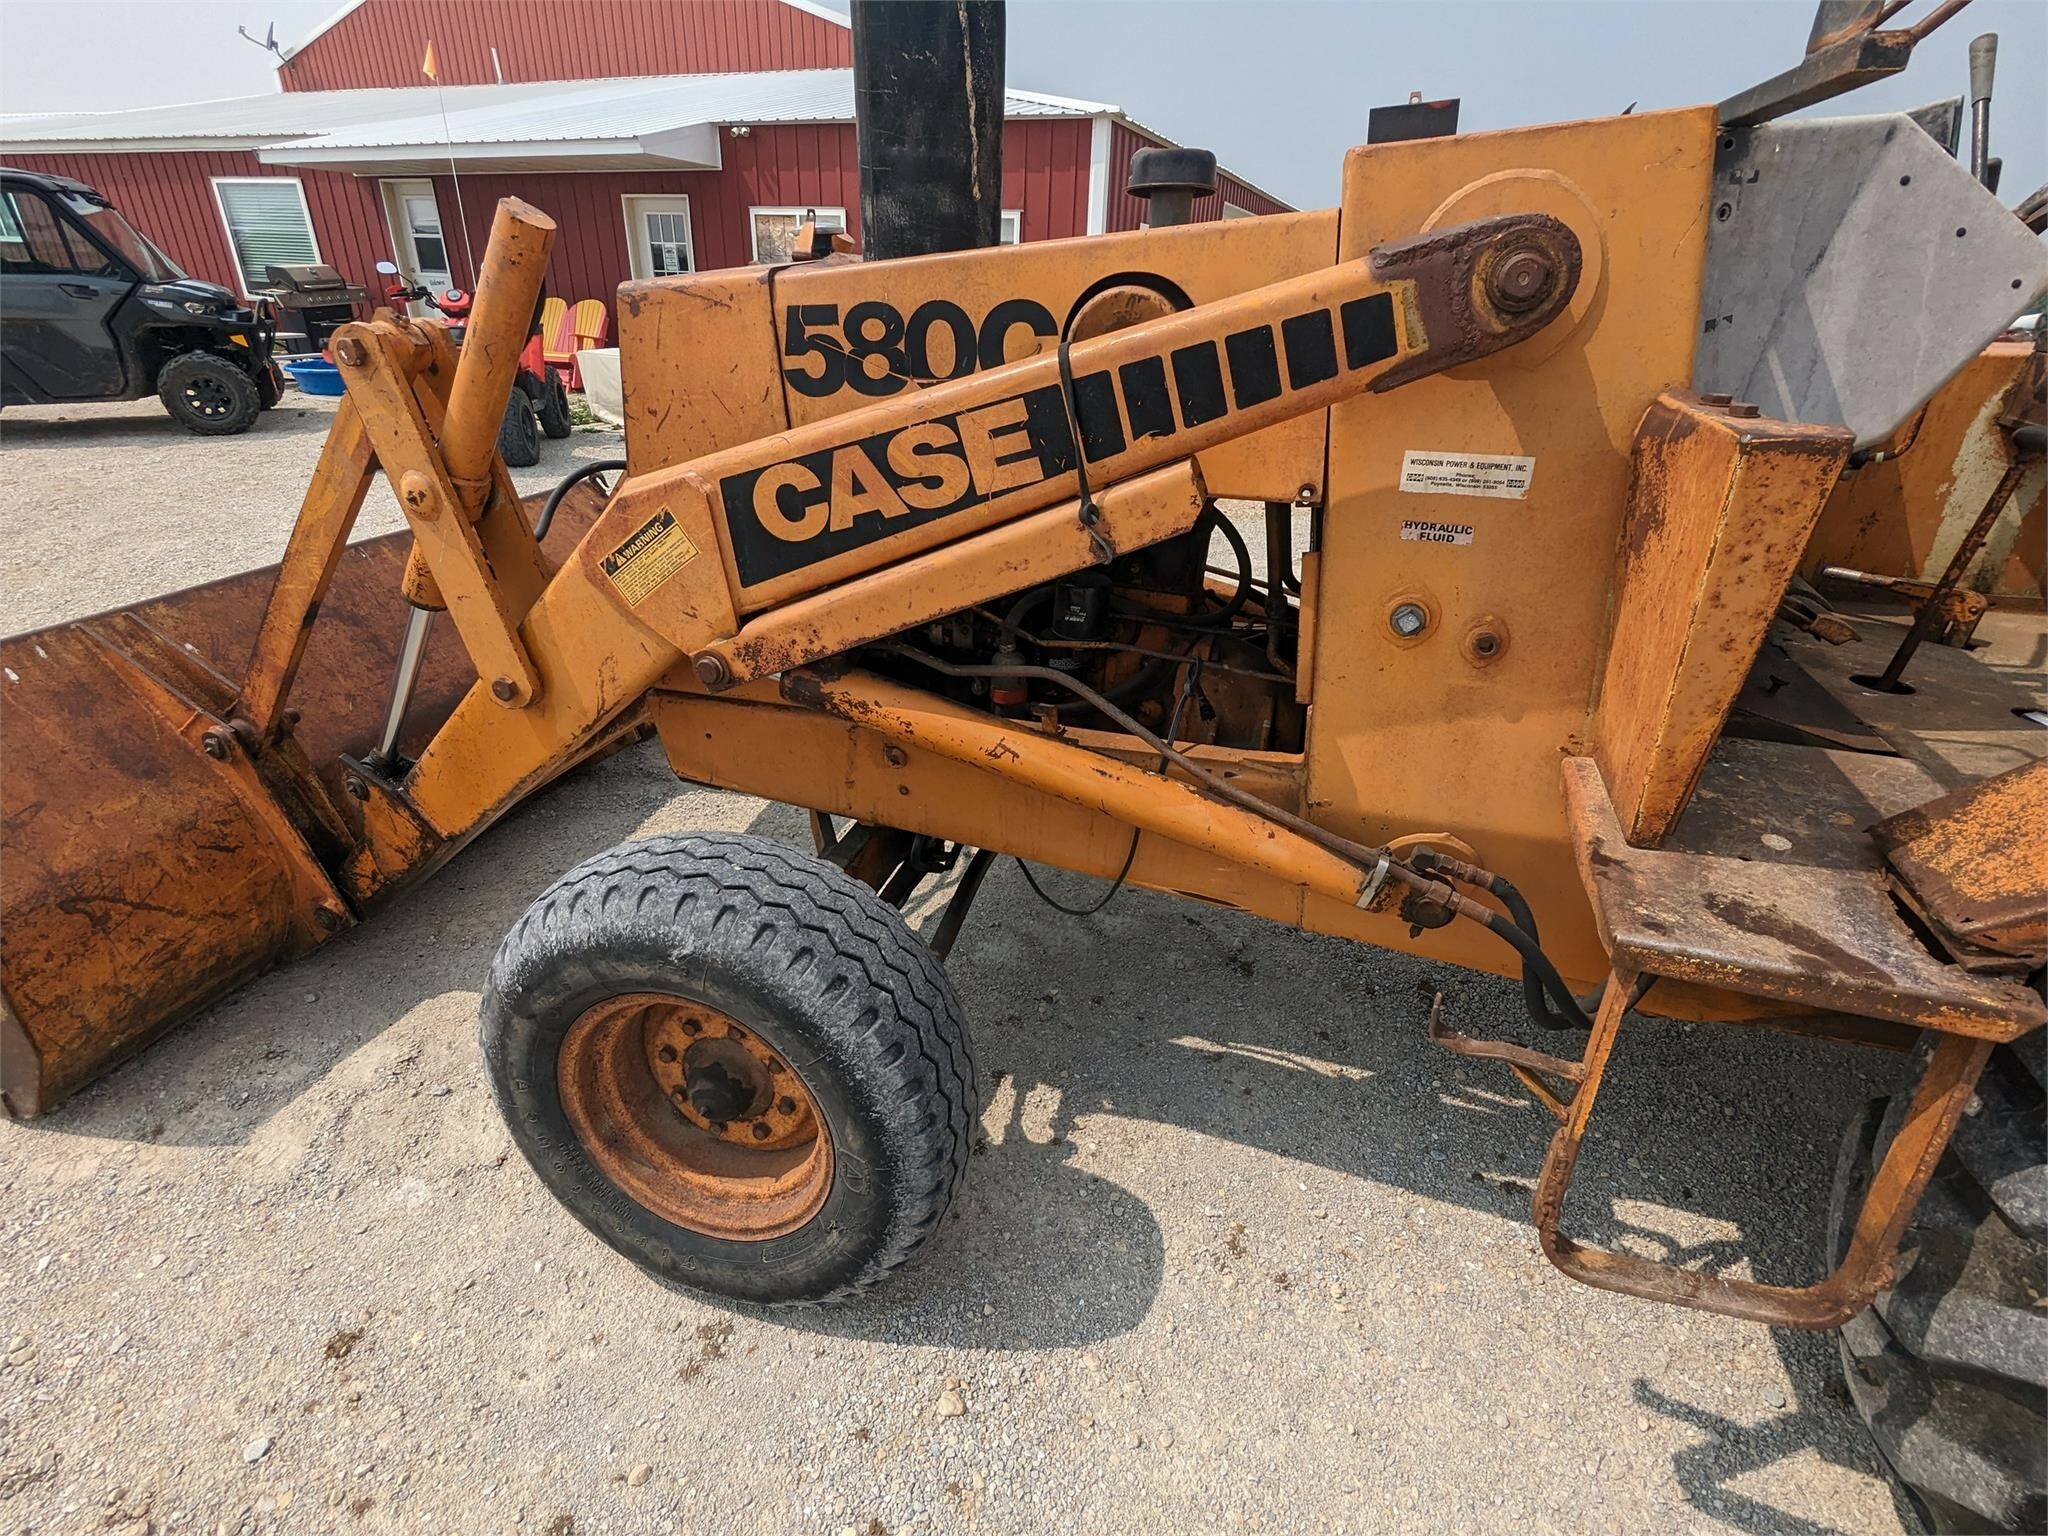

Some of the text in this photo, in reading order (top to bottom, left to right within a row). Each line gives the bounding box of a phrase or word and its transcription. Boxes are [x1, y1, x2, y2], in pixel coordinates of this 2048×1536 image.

[784, 299, 1059, 398] 580C
[752, 397, 1045, 543] CASE
[1410, 458, 1444, 467] WISCONSIN
[1446, 460, 1468, 469] POWER
[1470, 461, 1475, 469] &
[1515, 463, 1528, 473] INC.
[1404, 520, 1473, 535] HYDRAULIC
[1420, 531, 1455, 543] FLUID
[622, 522, 664, 560] WARNING
